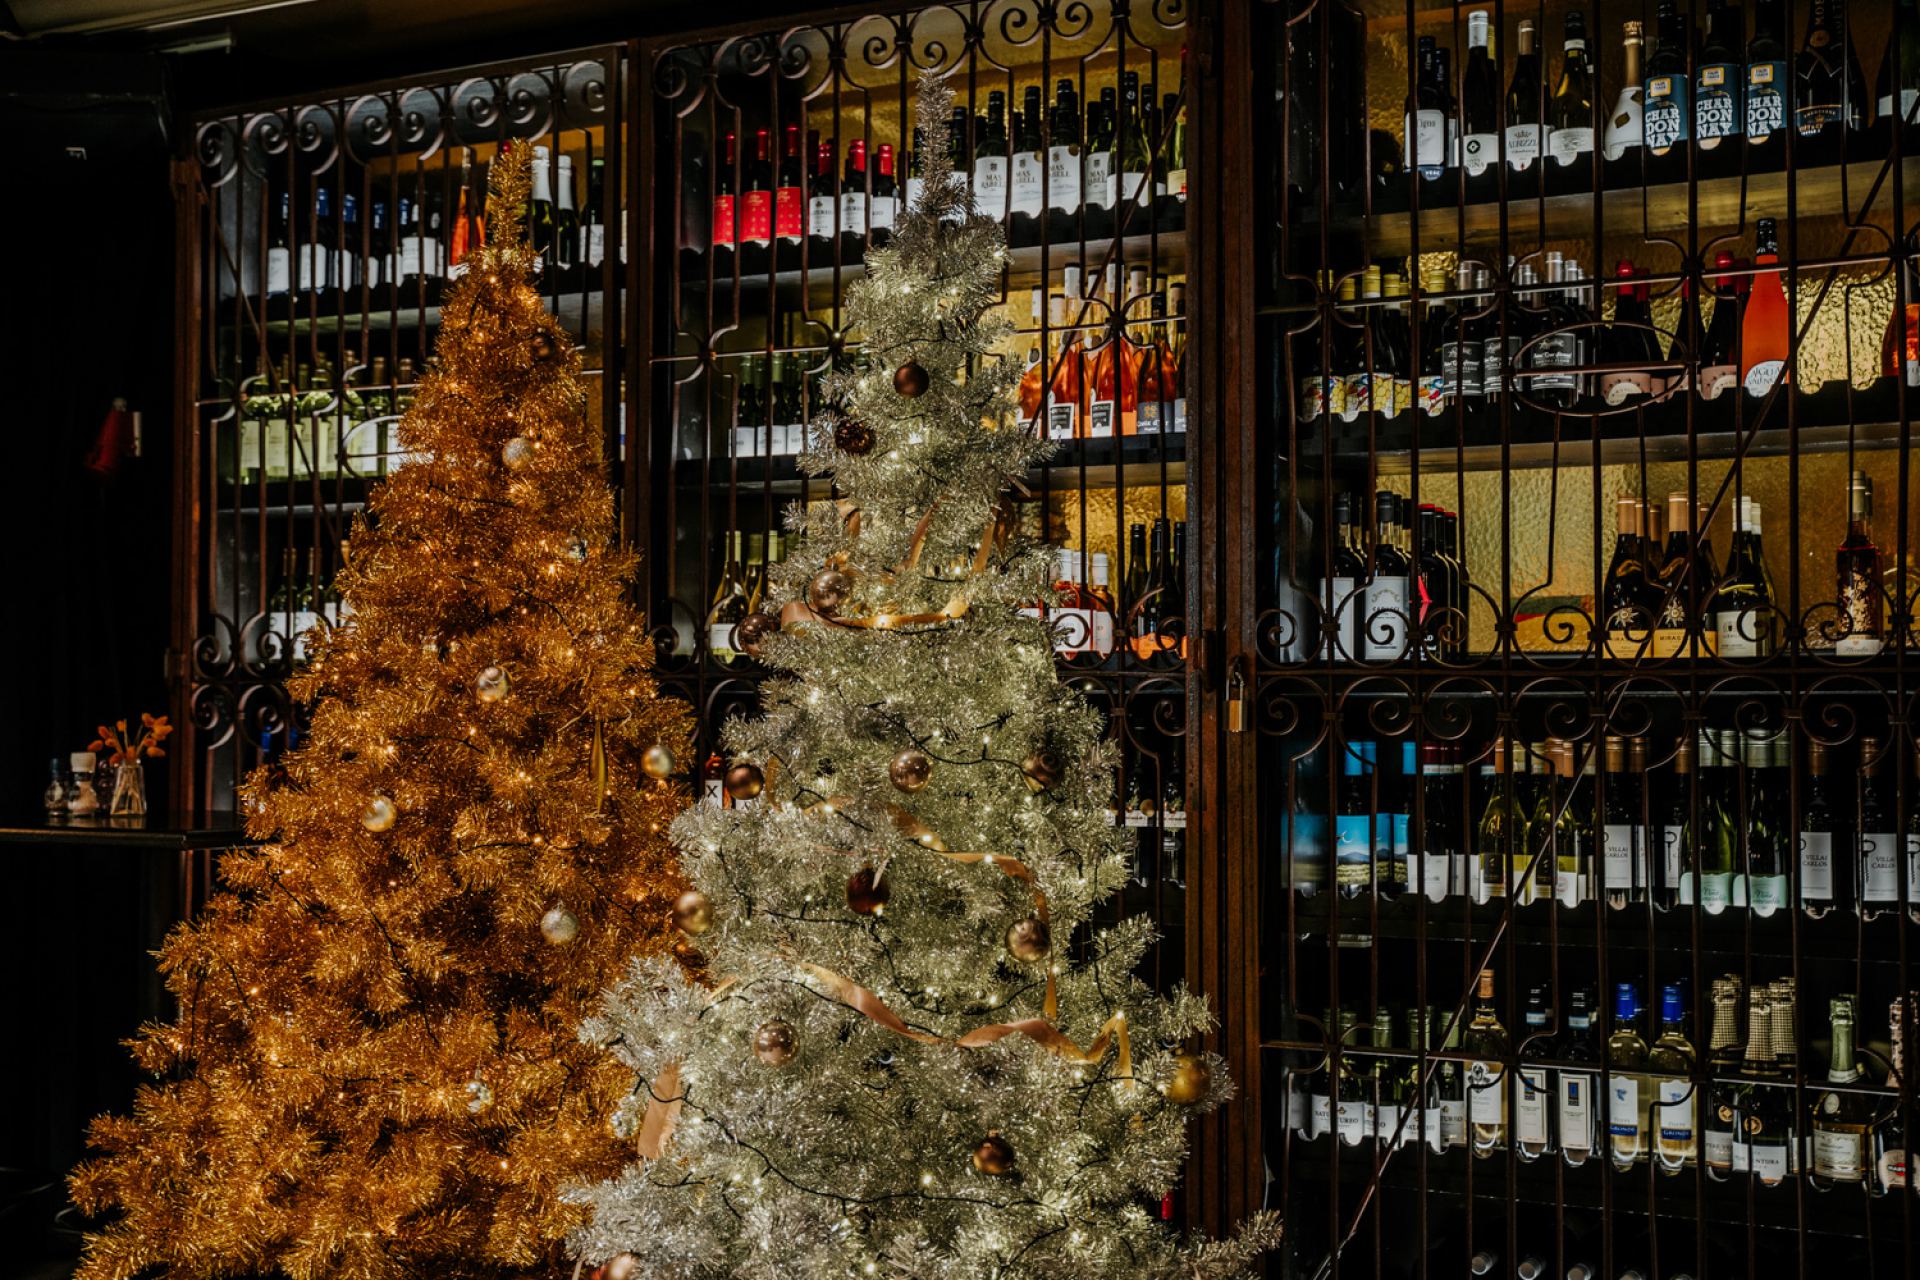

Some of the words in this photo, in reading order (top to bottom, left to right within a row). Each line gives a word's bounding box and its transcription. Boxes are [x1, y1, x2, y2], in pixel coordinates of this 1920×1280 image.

[1696, 97, 1732, 111] CHAR
[1645, 109, 1680, 122] CHAR
[1696, 109, 1732, 125] DON
[1748, 107, 1782, 122] DON
[1646, 119, 1680, 137] DON
[1697, 122, 1732, 138] NAY
